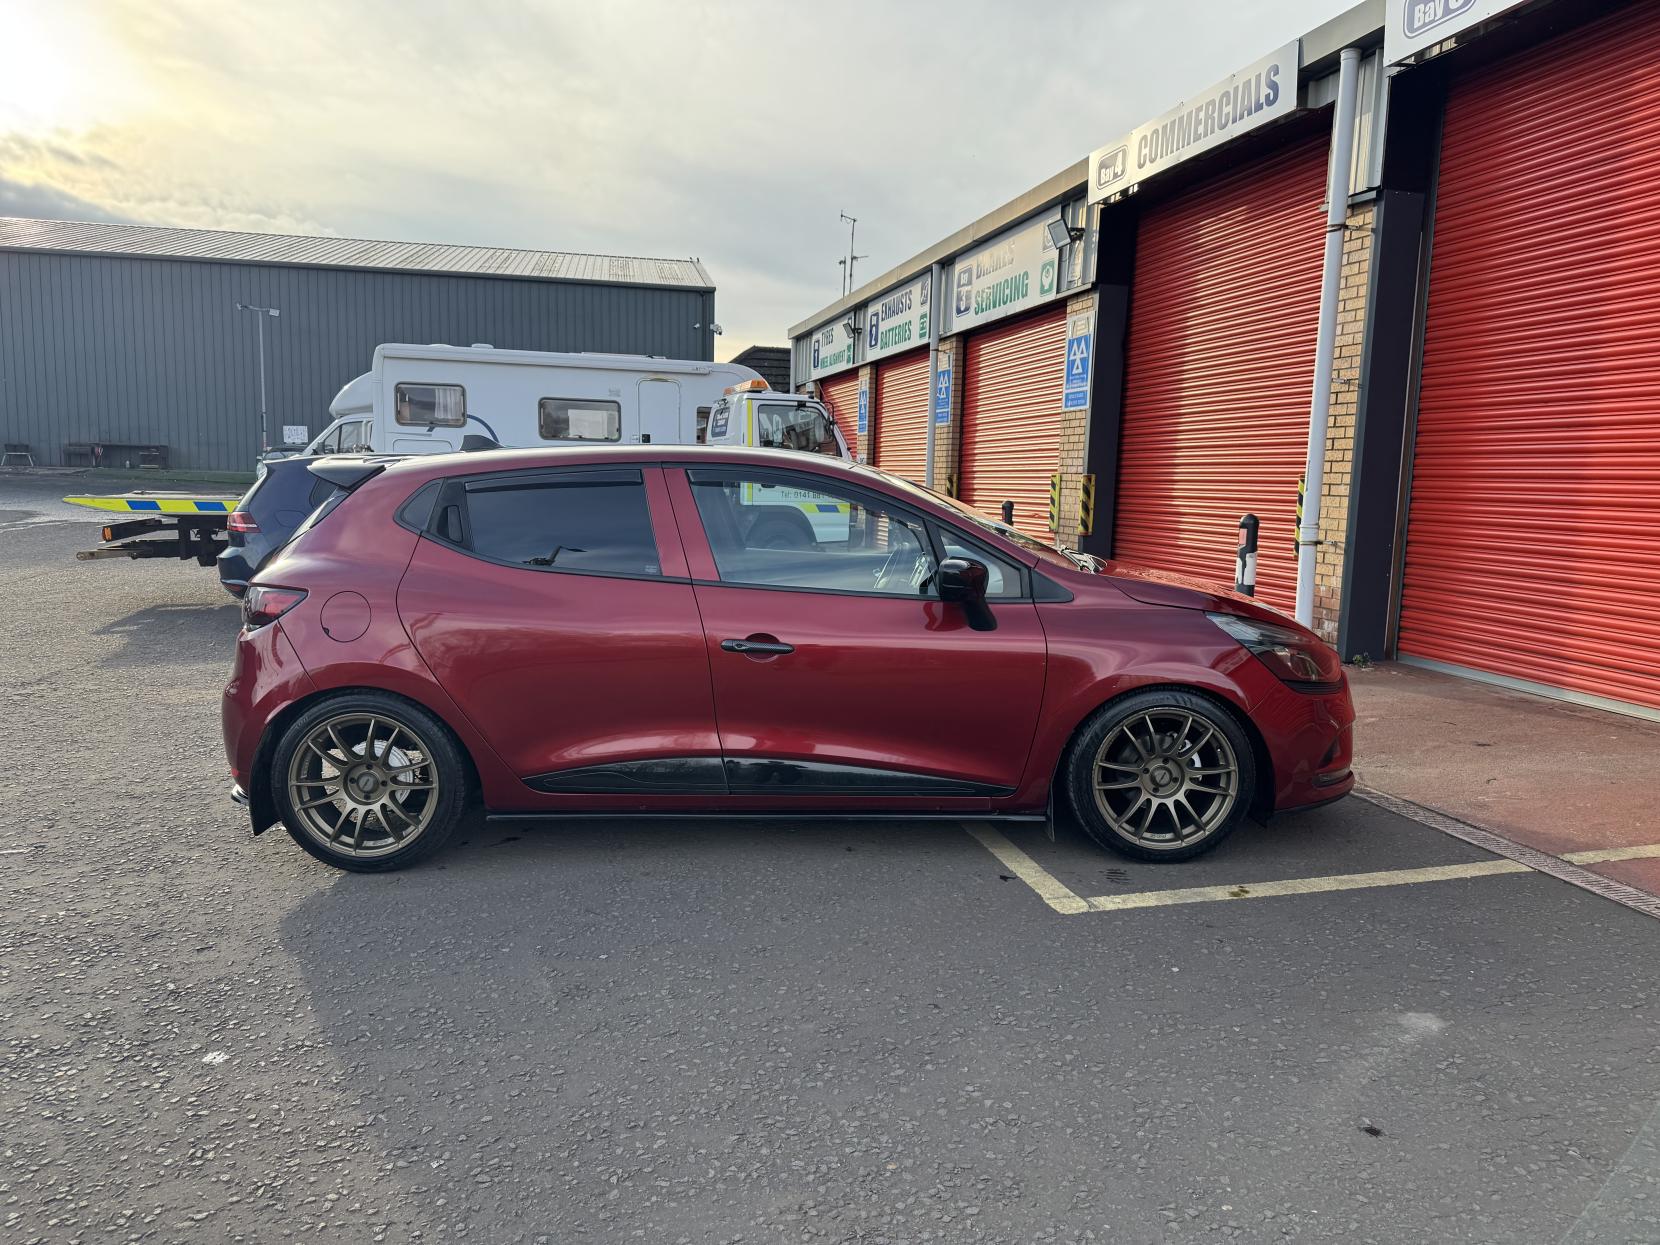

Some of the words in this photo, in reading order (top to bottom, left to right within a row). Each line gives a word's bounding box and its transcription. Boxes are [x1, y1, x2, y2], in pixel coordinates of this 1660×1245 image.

[1413, 0, 1444, 29] Bay
[1136, 63, 1281, 170] COMMERCIALS
[1100, 165, 1114, 185] Bay
[1113, 149, 1124, 176] 4
[881, 289, 913, 322] EXHAUSTS
[973, 270, 1030, 316] SERVICING
[879, 319, 912, 351] BATTERIES
